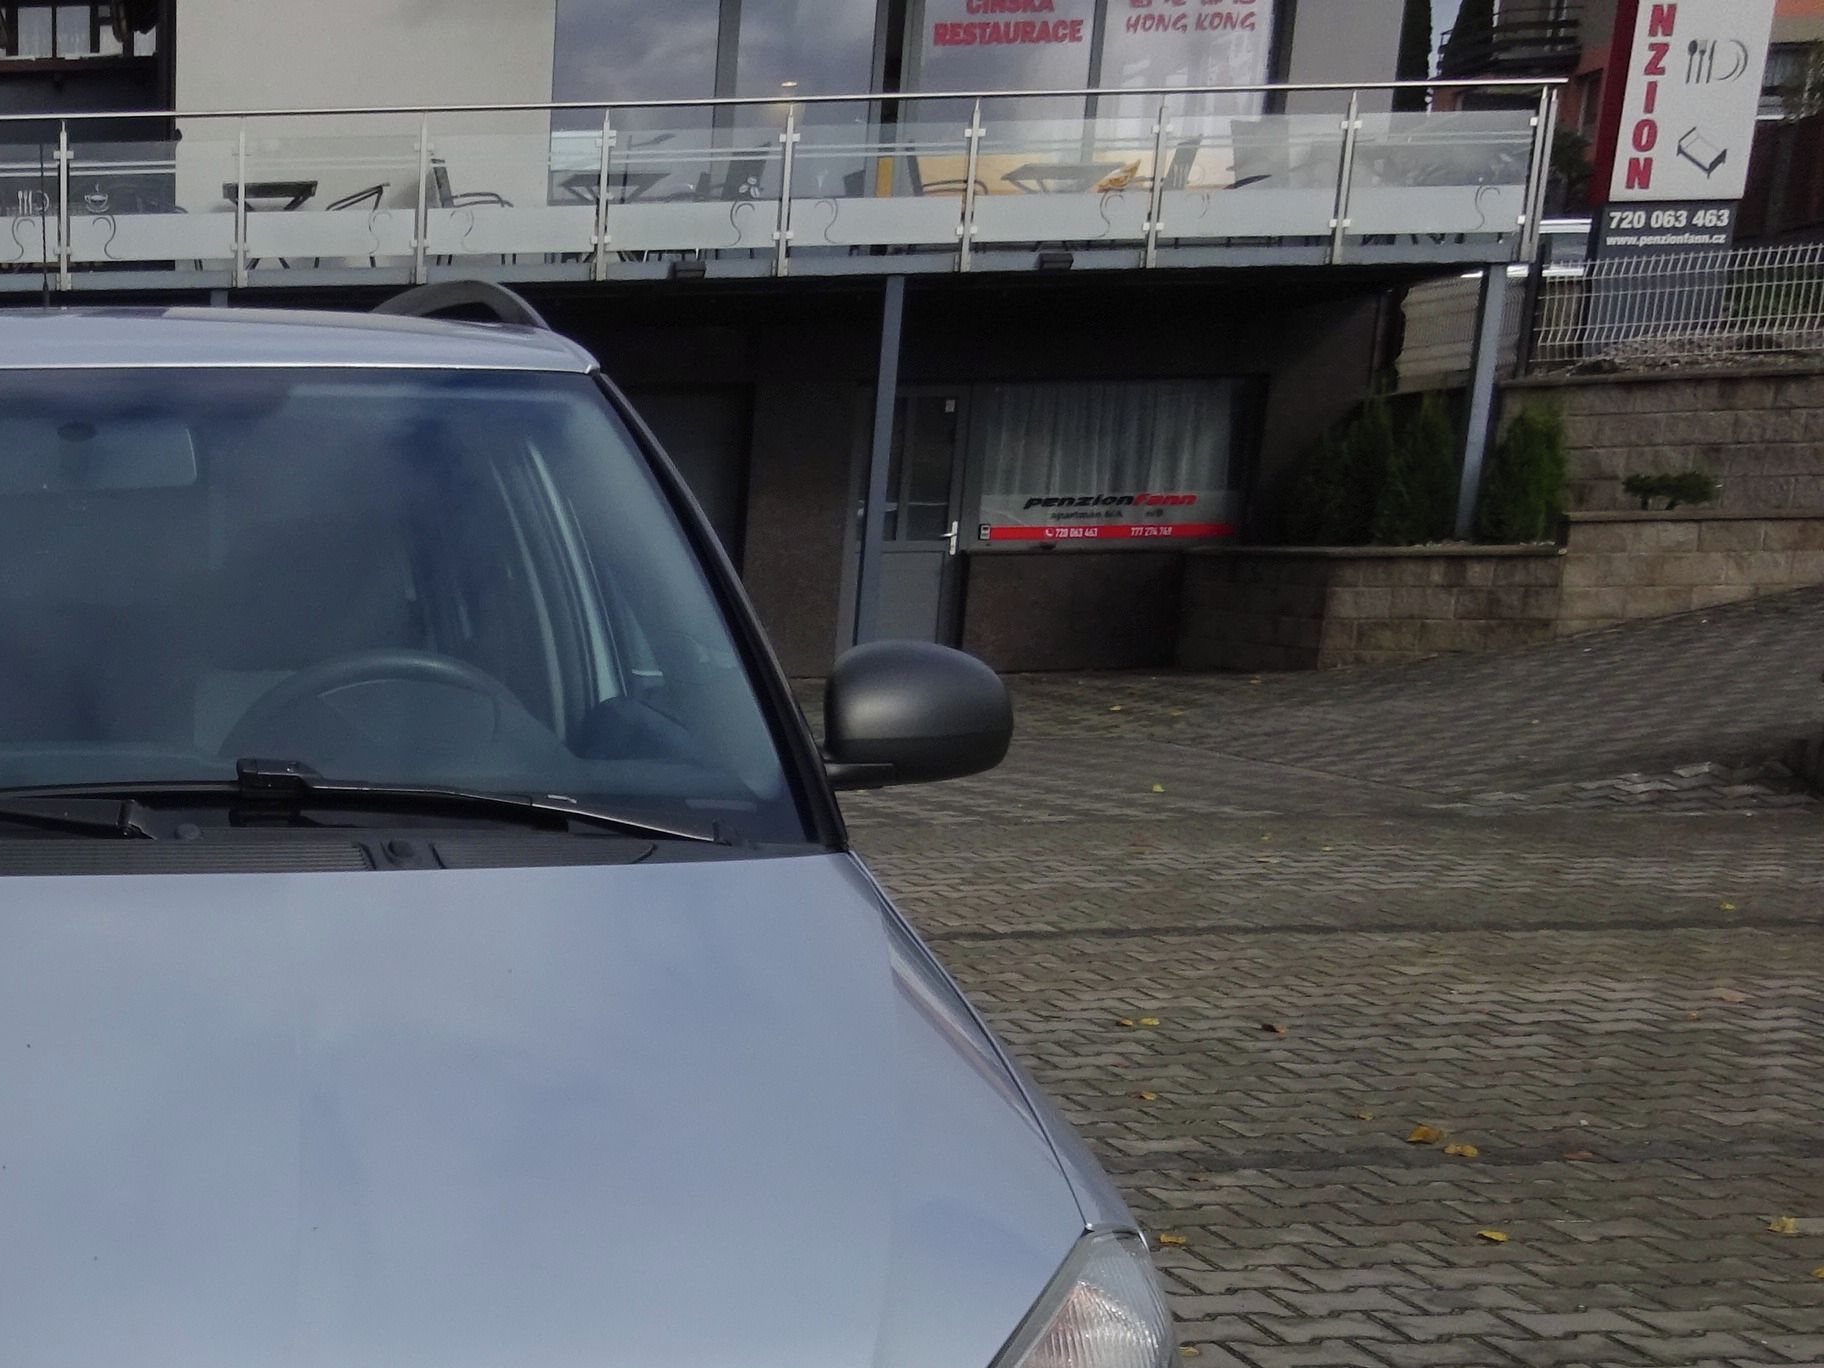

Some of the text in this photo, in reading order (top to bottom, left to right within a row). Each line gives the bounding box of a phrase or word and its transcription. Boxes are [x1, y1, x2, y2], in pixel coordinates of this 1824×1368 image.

[933, 19, 1084, 46] RESTAURACE
[1126, 11, 1257, 34] HONG KONG
[1609, 209, 1730, 229] 720 063 463
